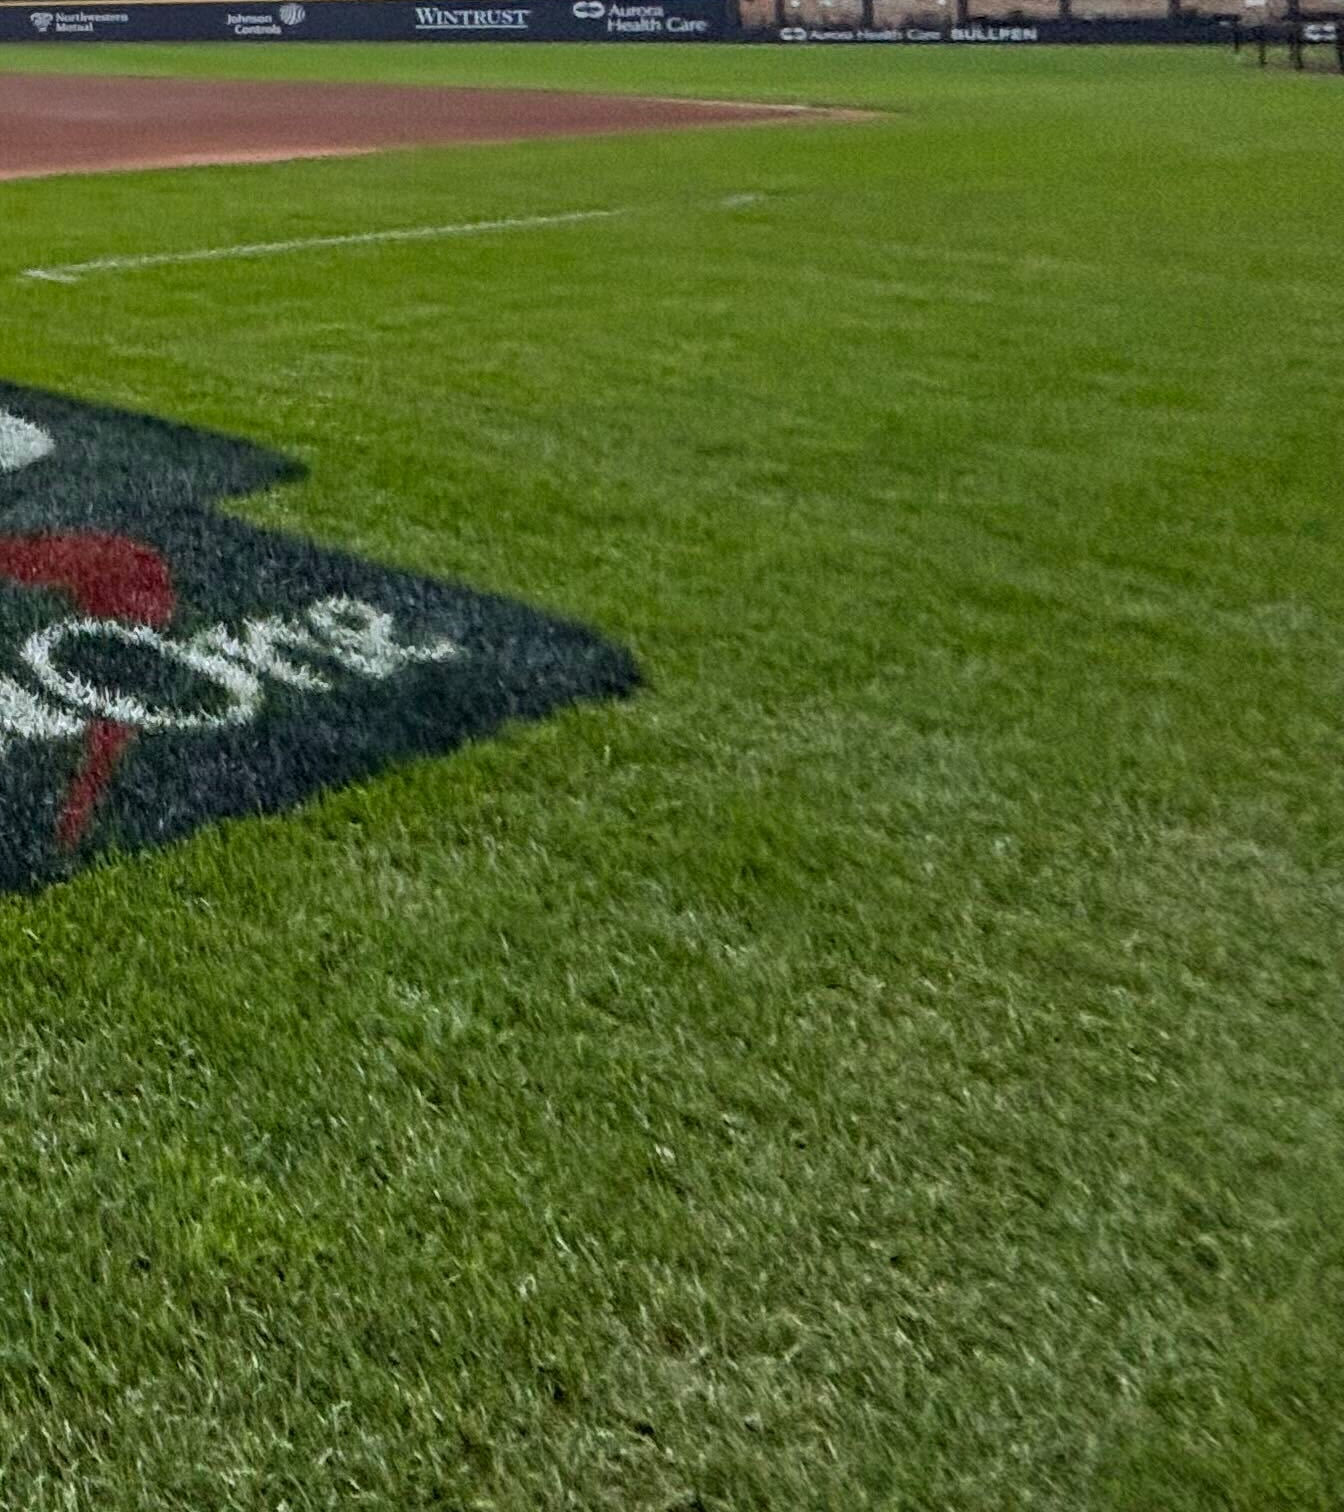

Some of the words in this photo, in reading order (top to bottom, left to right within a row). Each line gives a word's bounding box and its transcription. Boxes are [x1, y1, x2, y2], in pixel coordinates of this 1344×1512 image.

[55, 11, 129, 23] Northwestern
[415, 7, 528, 26] WINTRUST
[608, 4, 664, 17] Aurora
[226, 13, 272, 26] Johnson
[607, 17, 662, 33] Health
[665, 16, 707, 33] Care
[55, 22, 94, 33] Mutual
[234, 23, 282, 36] Controls
[950, 28, 1038, 42] BULLPEN
